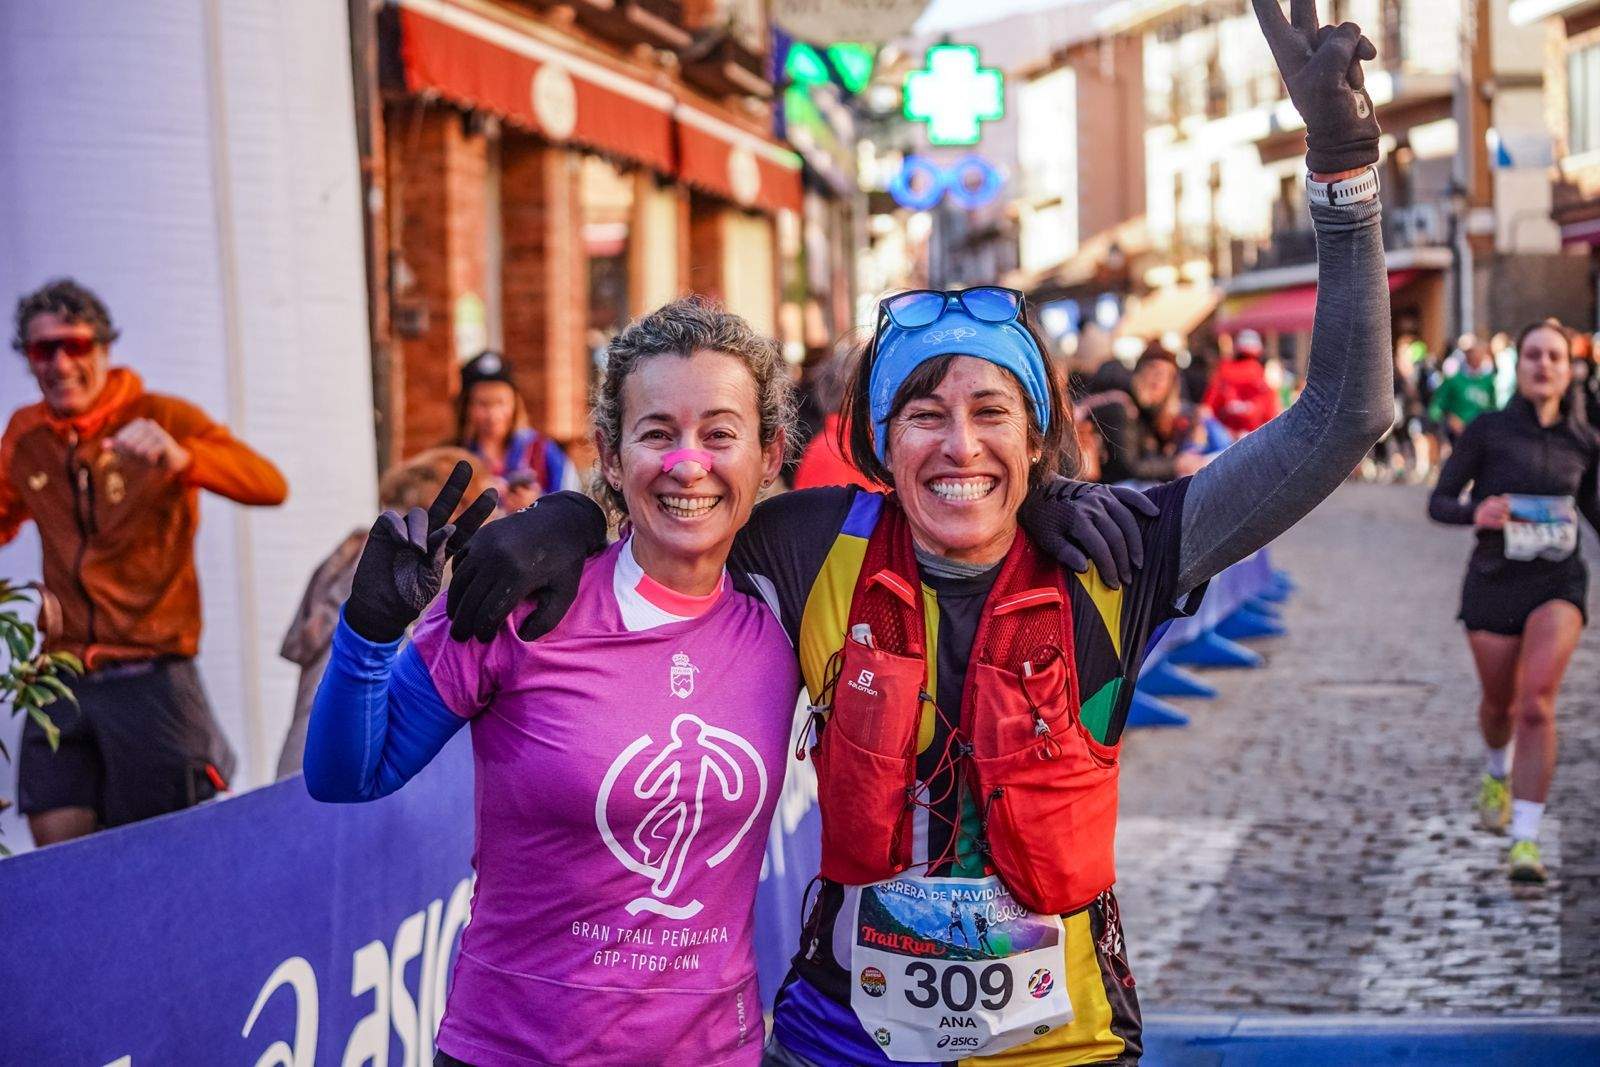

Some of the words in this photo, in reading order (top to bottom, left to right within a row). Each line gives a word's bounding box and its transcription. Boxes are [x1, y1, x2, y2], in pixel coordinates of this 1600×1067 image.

[873, 881, 927, 900] RRERA
[931, 891, 947, 900] DE
[572, 921, 610, 942] GRAN
[617, 928, 654, 945] TRAIL
[661, 926, 728, 947] PEÑALARA
[861, 926, 900, 948] Trail
[900, 935, 947, 956] Run
[340, 870, 478, 1067] asic
[904, 961, 1014, 1012] 309
[939, 1016, 977, 1028] ANA
[950, 1037, 979, 1047] asics
